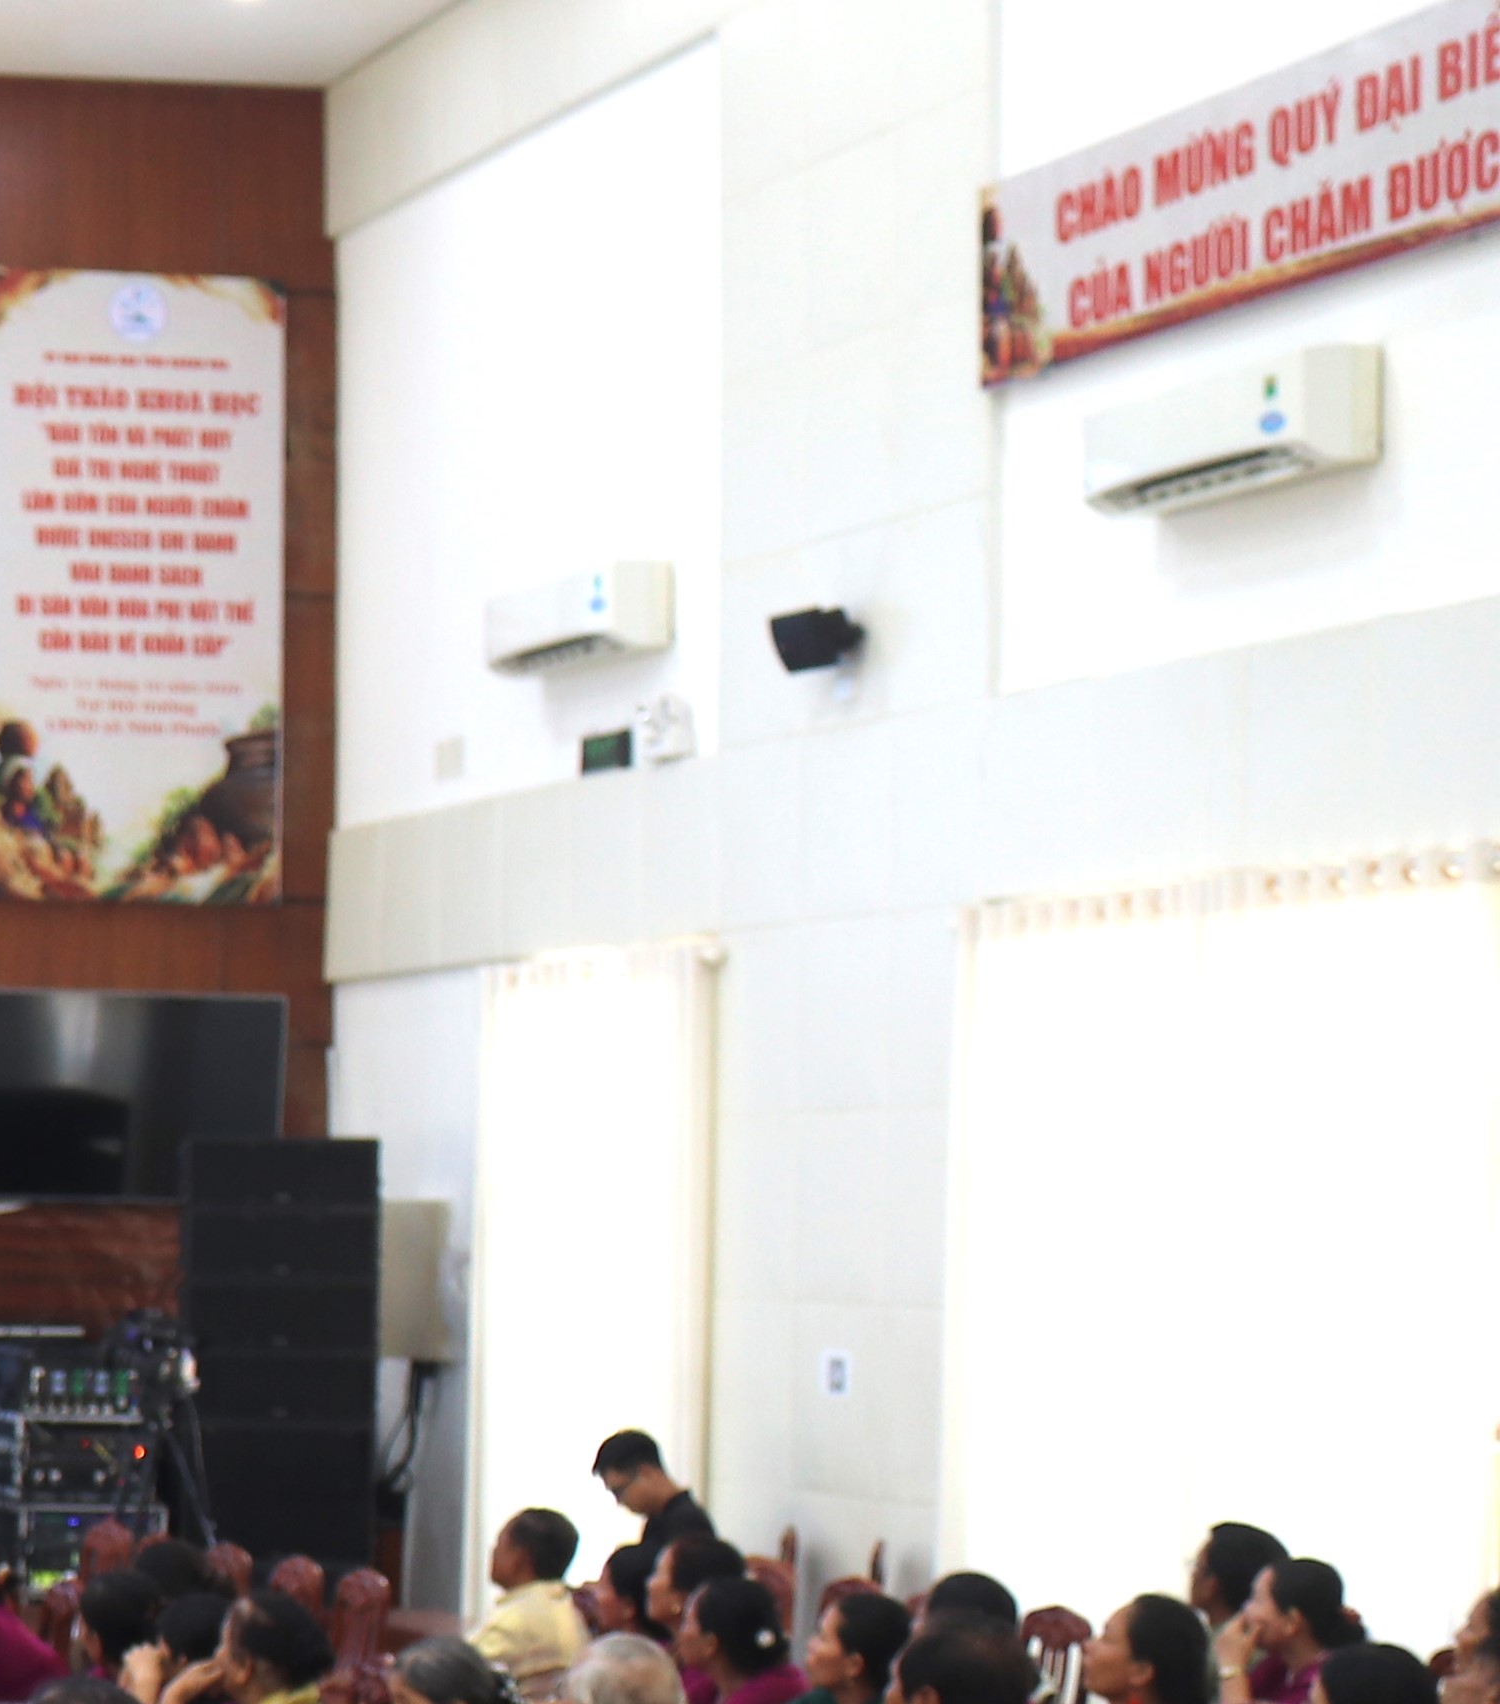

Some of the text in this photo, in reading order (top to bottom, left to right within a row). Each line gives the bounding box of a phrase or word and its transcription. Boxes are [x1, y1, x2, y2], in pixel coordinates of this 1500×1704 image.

[1055, 159, 1141, 243] CHÀO
[1153, 122, 1256, 206] MỪNG
[1269, 77, 1342, 167] QUÝ
[1355, 55, 1423, 133] ĐẠI
[1067, 258, 1133, 329] CỦA
